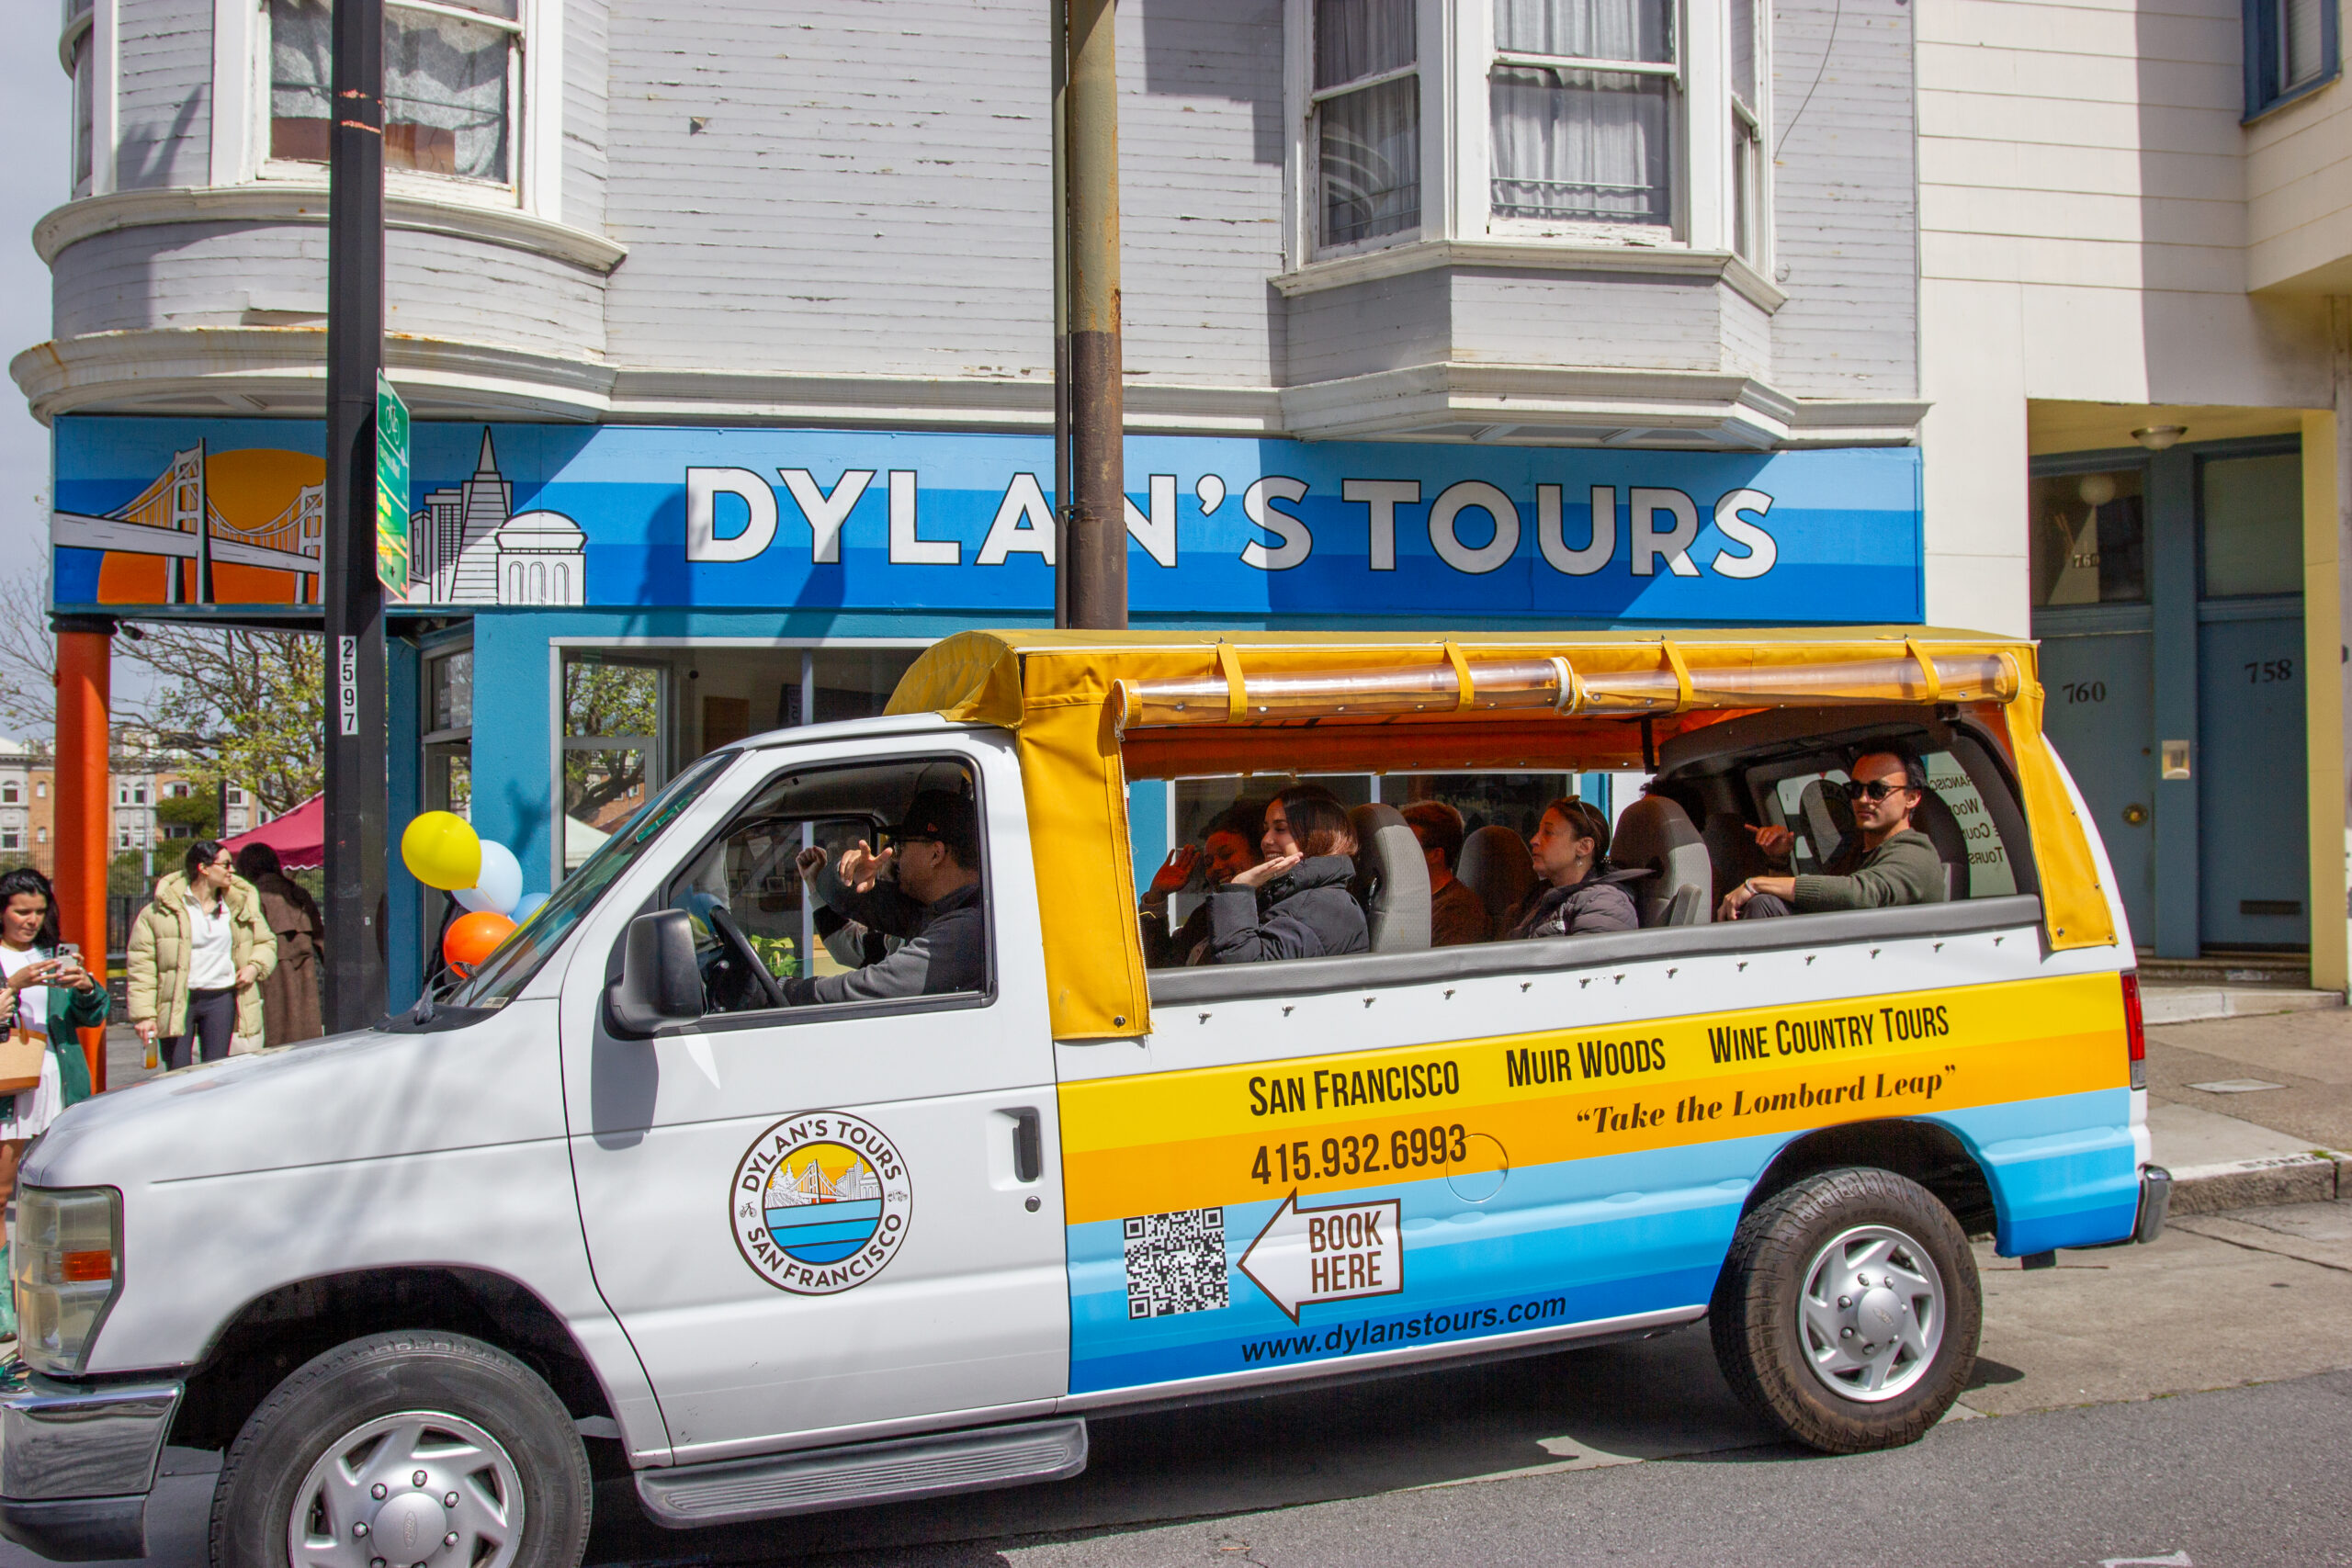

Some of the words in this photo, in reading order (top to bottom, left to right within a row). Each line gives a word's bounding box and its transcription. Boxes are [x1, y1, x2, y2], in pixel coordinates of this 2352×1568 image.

[684, 466, 1314, 571] DYLAN'S
[1341, 477, 1778, 581] TOURS
[341, 638, 356, 733] 2597
[2063, 681, 2107, 705] 760
[2245, 659, 2293, 684] 758
[1577, 1101, 1666, 1134] "Take
[1676, 1095, 1723, 1123] the
[1734, 1075, 1866, 1117] Lombard
[1875, 1064, 1956, 1100] Leap"
[741, 1119, 828, 1193] DYLAN'S
[836, 1120, 902, 1181] TOURS
[1250, 1123, 1467, 1185] 415.932.6993
[747, 1226, 785, 1272] SAN
[782, 1213, 902, 1288] FRANCISCO
[1309, 1211, 1384, 1254] BOOK
[1311, 1250, 1383, 1293] HERE
[1241, 1296, 1566, 1363] www.dylanstours.com
